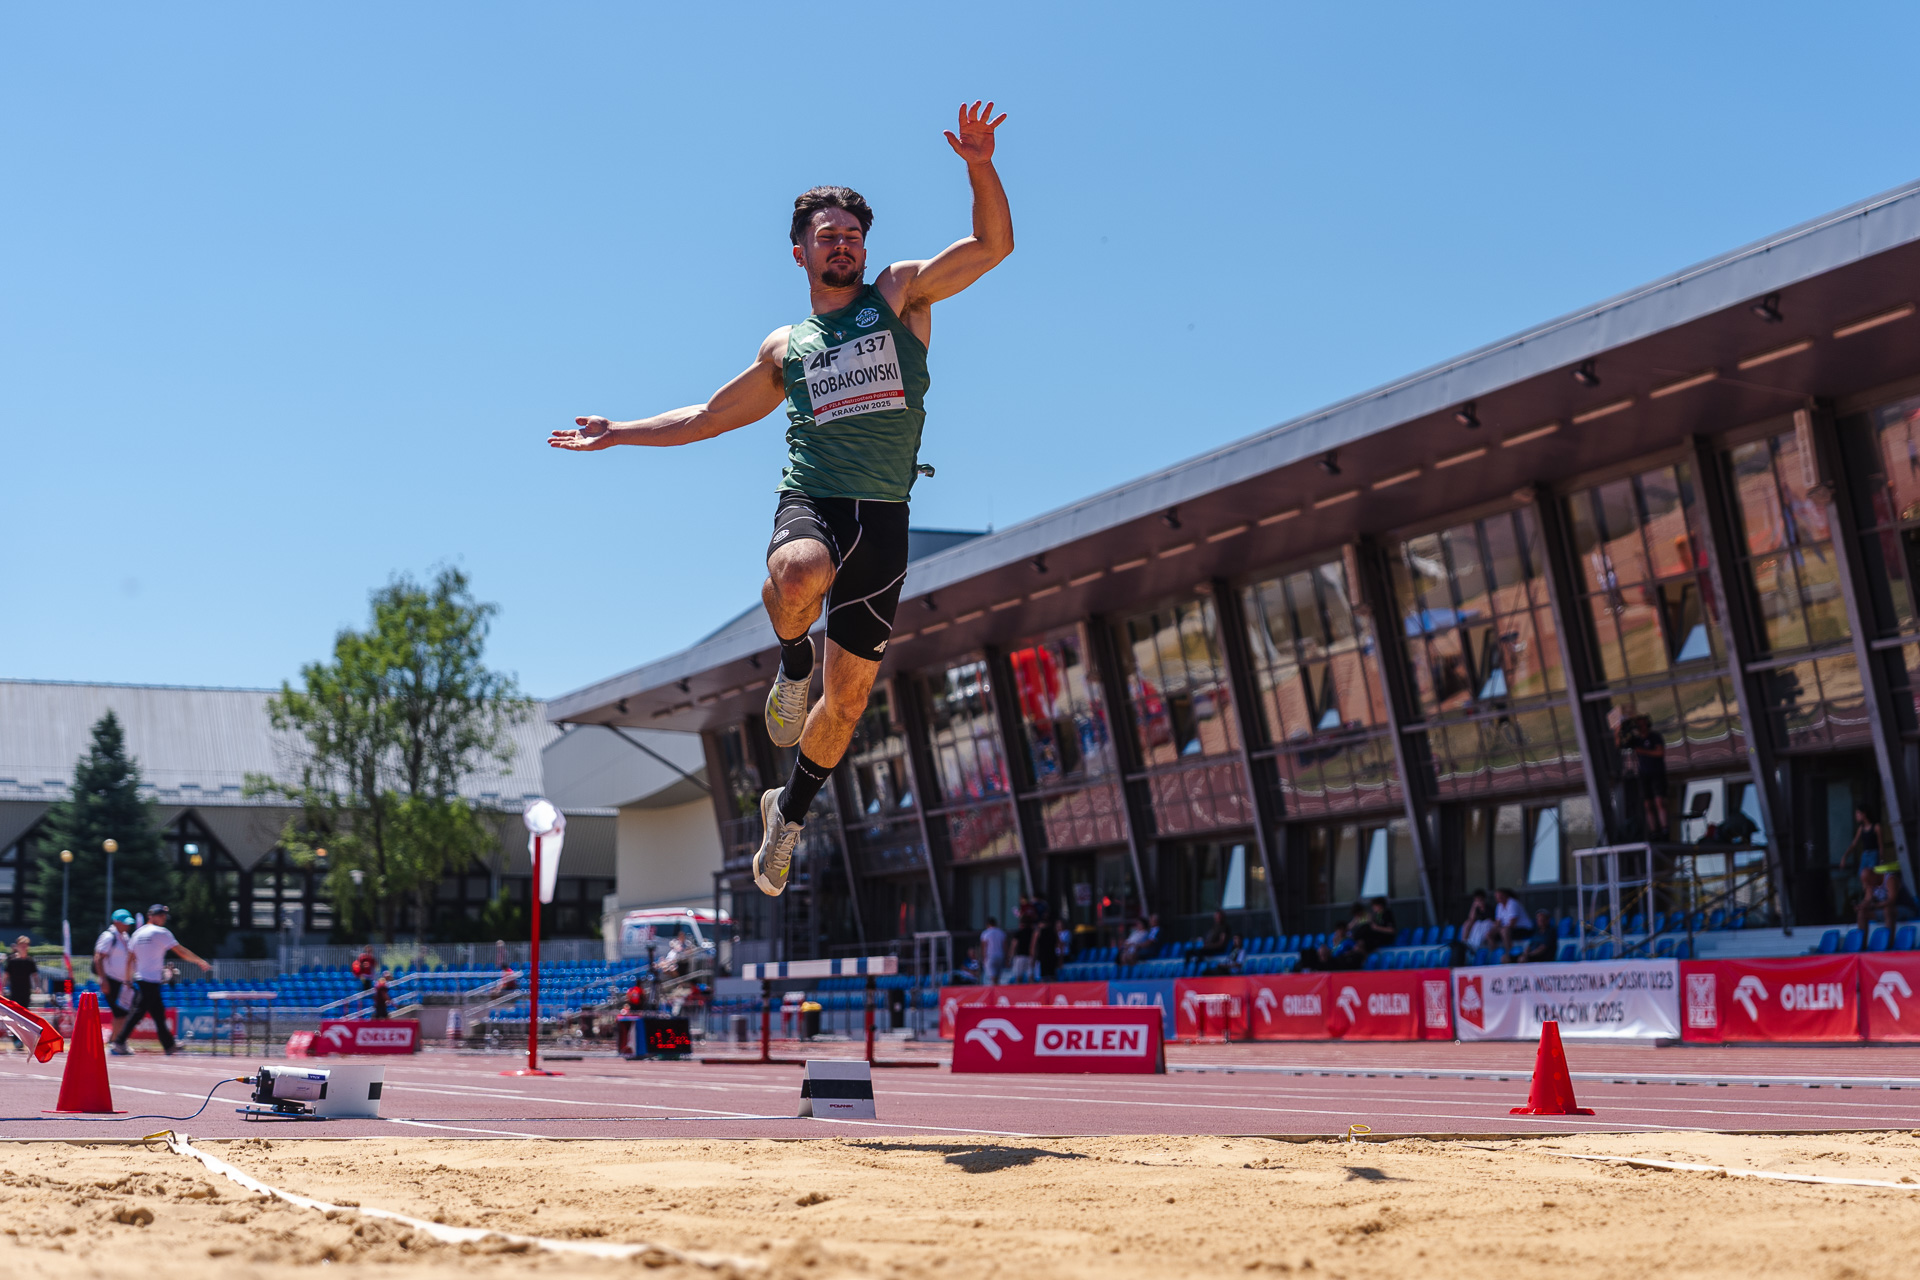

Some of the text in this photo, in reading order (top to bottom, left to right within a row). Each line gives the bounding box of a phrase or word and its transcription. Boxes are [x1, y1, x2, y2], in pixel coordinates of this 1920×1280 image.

[854, 335, 886, 356] 137
[811, 363, 898, 399] ROBAKOWSKI
[832, 400, 891, 417] KRAKÓW 2025
[1283, 995, 1322, 1016] ORLEN
[1368, 994, 1410, 1015] ORLEN
[1780, 983, 1844, 1010] ORLEN
[1594, 1001, 1624, 1023] 2025
[1043, 1030, 1139, 1050] ORLEN
